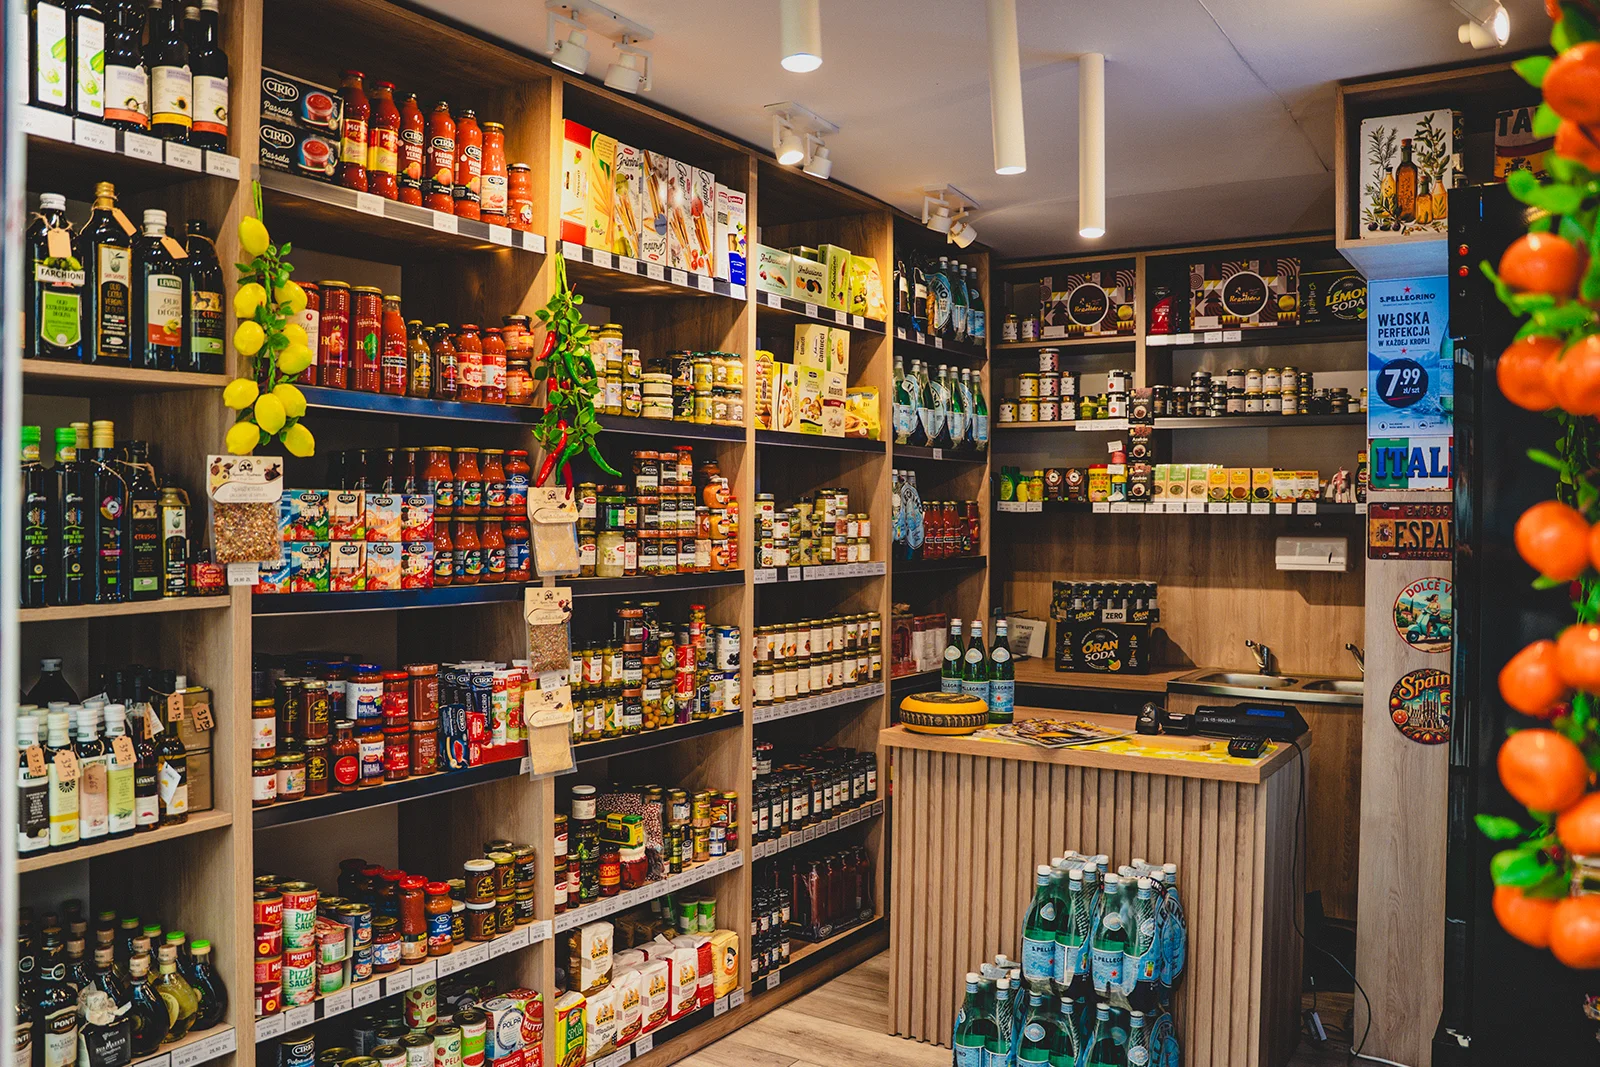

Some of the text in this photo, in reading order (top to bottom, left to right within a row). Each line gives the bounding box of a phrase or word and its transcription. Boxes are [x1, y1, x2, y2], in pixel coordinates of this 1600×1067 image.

[265, 80, 296, 97] CIRIO
[263, 100, 294, 117] Passata
[1497, 108, 1537, 136] TA
[262, 127, 292, 144] CIRIO
[260, 147, 291, 163] Passata
[41, 267, 84, 280] FARCHIONI
[160, 279, 181, 288] LEVANT
[1379, 293, 1436, 303] S.PELLEGRINO
[1331, 297, 1366, 313] SODA
[1377, 311, 1430, 327] WŁOSKA
[1378, 326, 1430, 339] PERFEKCJA
[1385, 338, 1408, 347] KAŻDEJ
[1410, 337, 1430, 346] KROPLI
[1384, 368, 1421, 397] 7.99
[1405, 581, 1440, 598] DOLCE
[1075, 610, 1096, 620] LEMON
[1105, 611, 1123, 620] ZERO
[1132, 610, 1149, 618] ORAN
[1082, 639, 1119, 654] ORAN
[1084, 650, 1116, 662] SODA
[474, 677, 493, 685] CIRIO
[1399, 671, 1450, 699] Spain
[299, 895, 316, 903] MUTTI
[295, 910, 316, 922] PIZZA
[291, 952, 312, 961] MUTTI
[591, 949, 609, 959] CAPUTO
[289, 967, 313, 980] PIZZA
[289, 978, 313, 988] SAUCE
[680, 976, 696, 986] CAPUTO
[649, 986, 666, 997] CAPUTO
[421, 999, 437, 1009] PELA
[623, 999, 640, 1011] CAPUTO
[53, 1016, 76, 1029] PONTI
[502, 1017, 521, 1029] POLPA
[596, 1015, 615, 1026] CAPUTO
[445, 1056, 460, 1066] PELA
